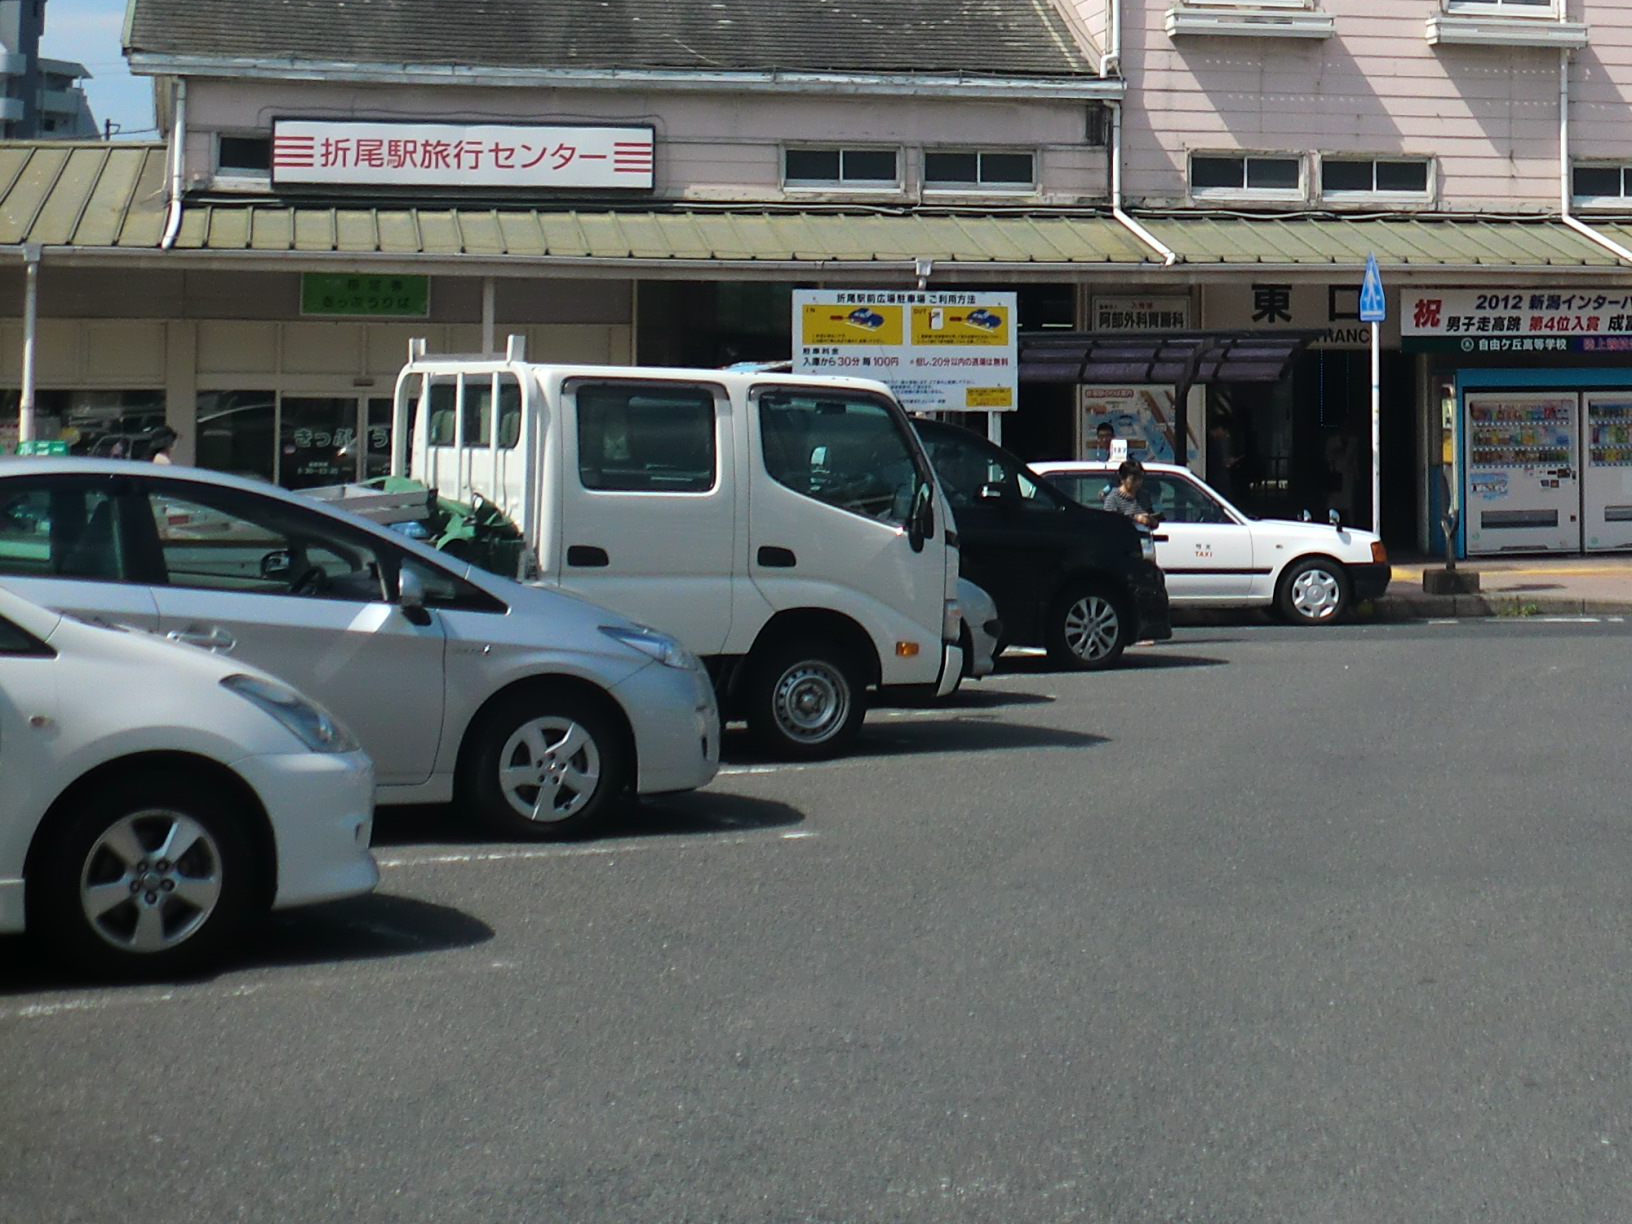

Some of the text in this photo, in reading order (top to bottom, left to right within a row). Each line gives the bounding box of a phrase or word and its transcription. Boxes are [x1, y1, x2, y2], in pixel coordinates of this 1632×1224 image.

[320, 137, 607, 170] 折尾駅旅行センター
[836, 293, 976, 305] 折尾駅前広場駐車場 ご利用方法
[1475, 295, 1523, 310] 2012
[1413, 298, 1442, 328] 祝
[1446, 316, 1521, 333] 男子走高跳
[1528, 316, 1600, 332] 第4位入賞
